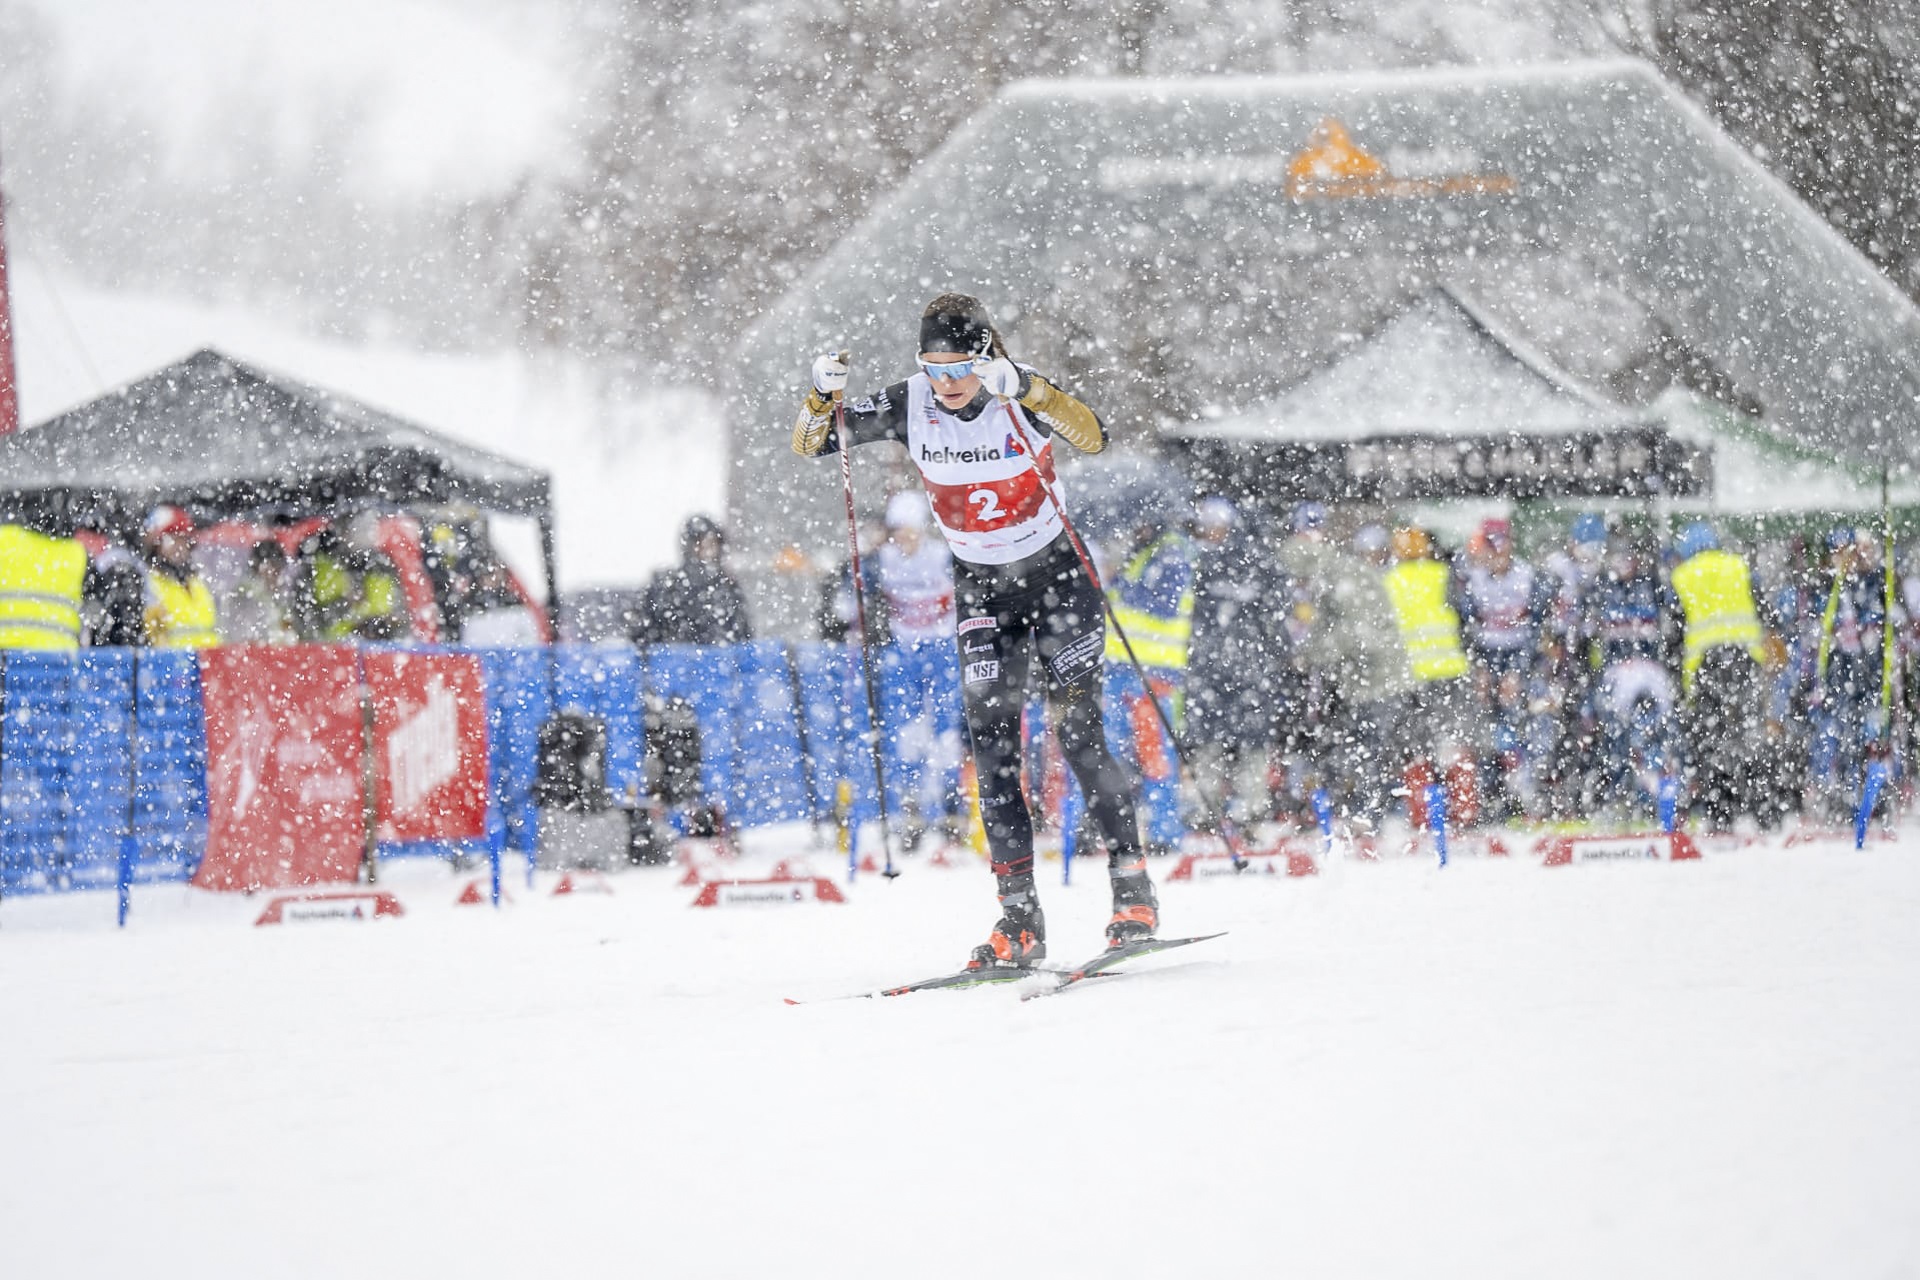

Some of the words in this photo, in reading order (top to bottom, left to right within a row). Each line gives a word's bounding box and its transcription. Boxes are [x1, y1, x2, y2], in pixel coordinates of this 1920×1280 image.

[921, 443, 1001, 464] helvetia
[968, 488, 1007, 521] 2
[972, 663, 996, 679] NSF
